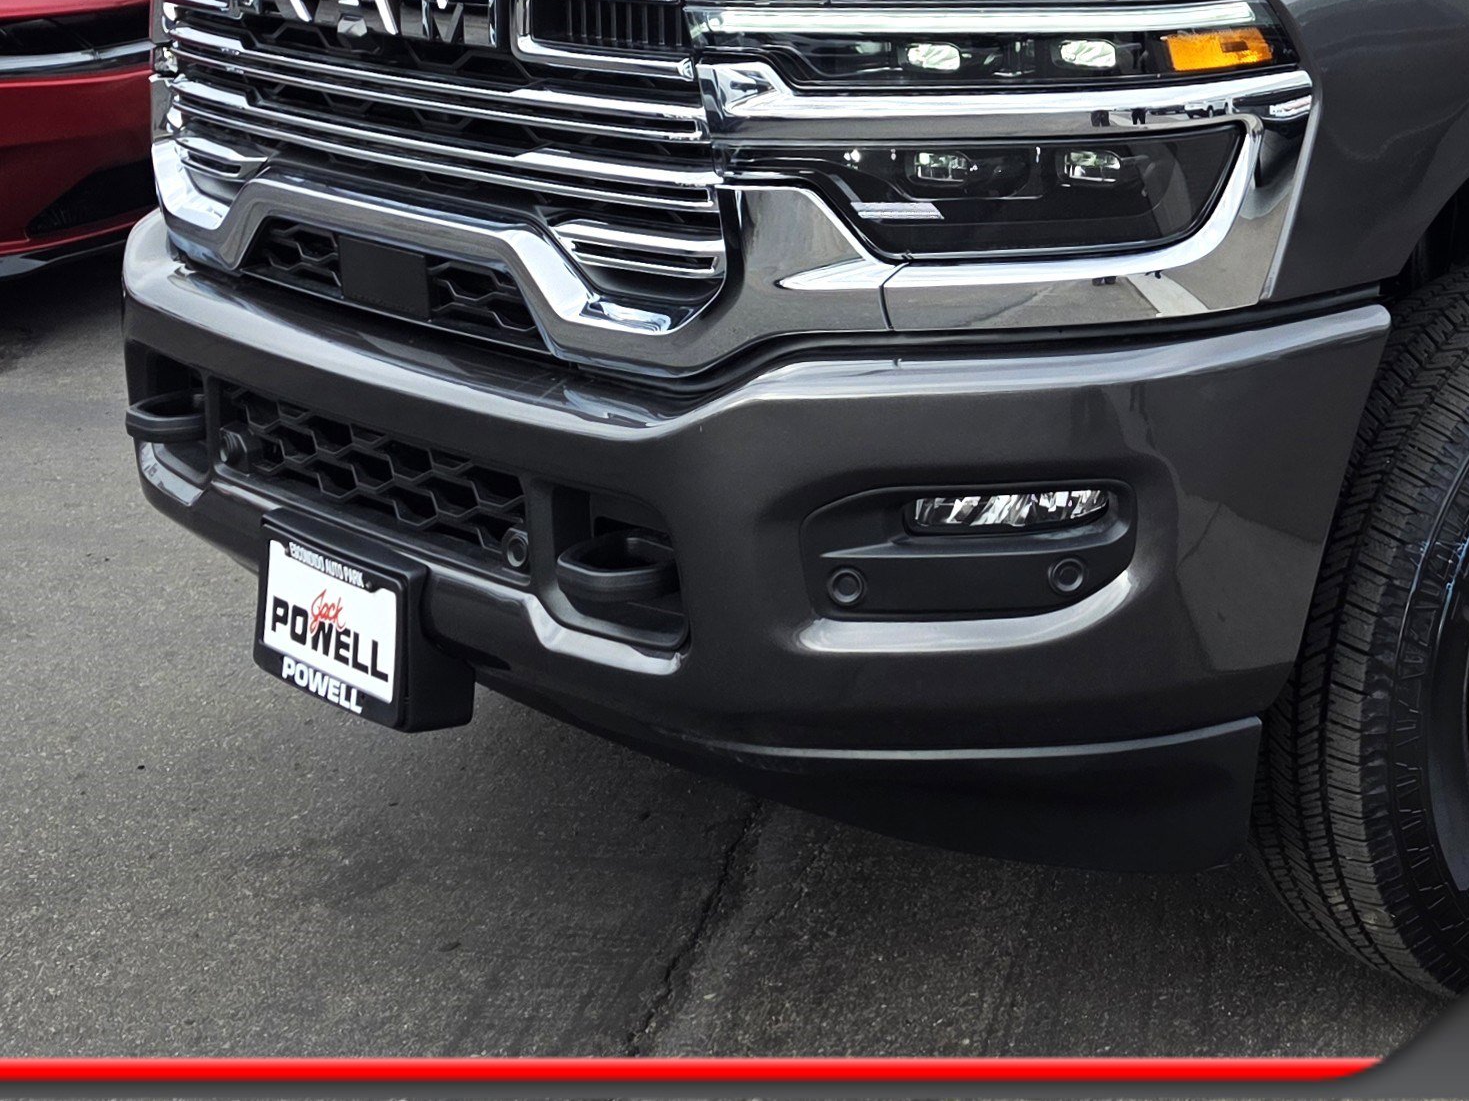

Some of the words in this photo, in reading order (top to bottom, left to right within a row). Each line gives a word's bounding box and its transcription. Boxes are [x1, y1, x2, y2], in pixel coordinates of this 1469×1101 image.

[271, 595, 389, 683] POWELL
[309, 588, 347, 634] Jack
[281, 655, 363, 715] POWELL
